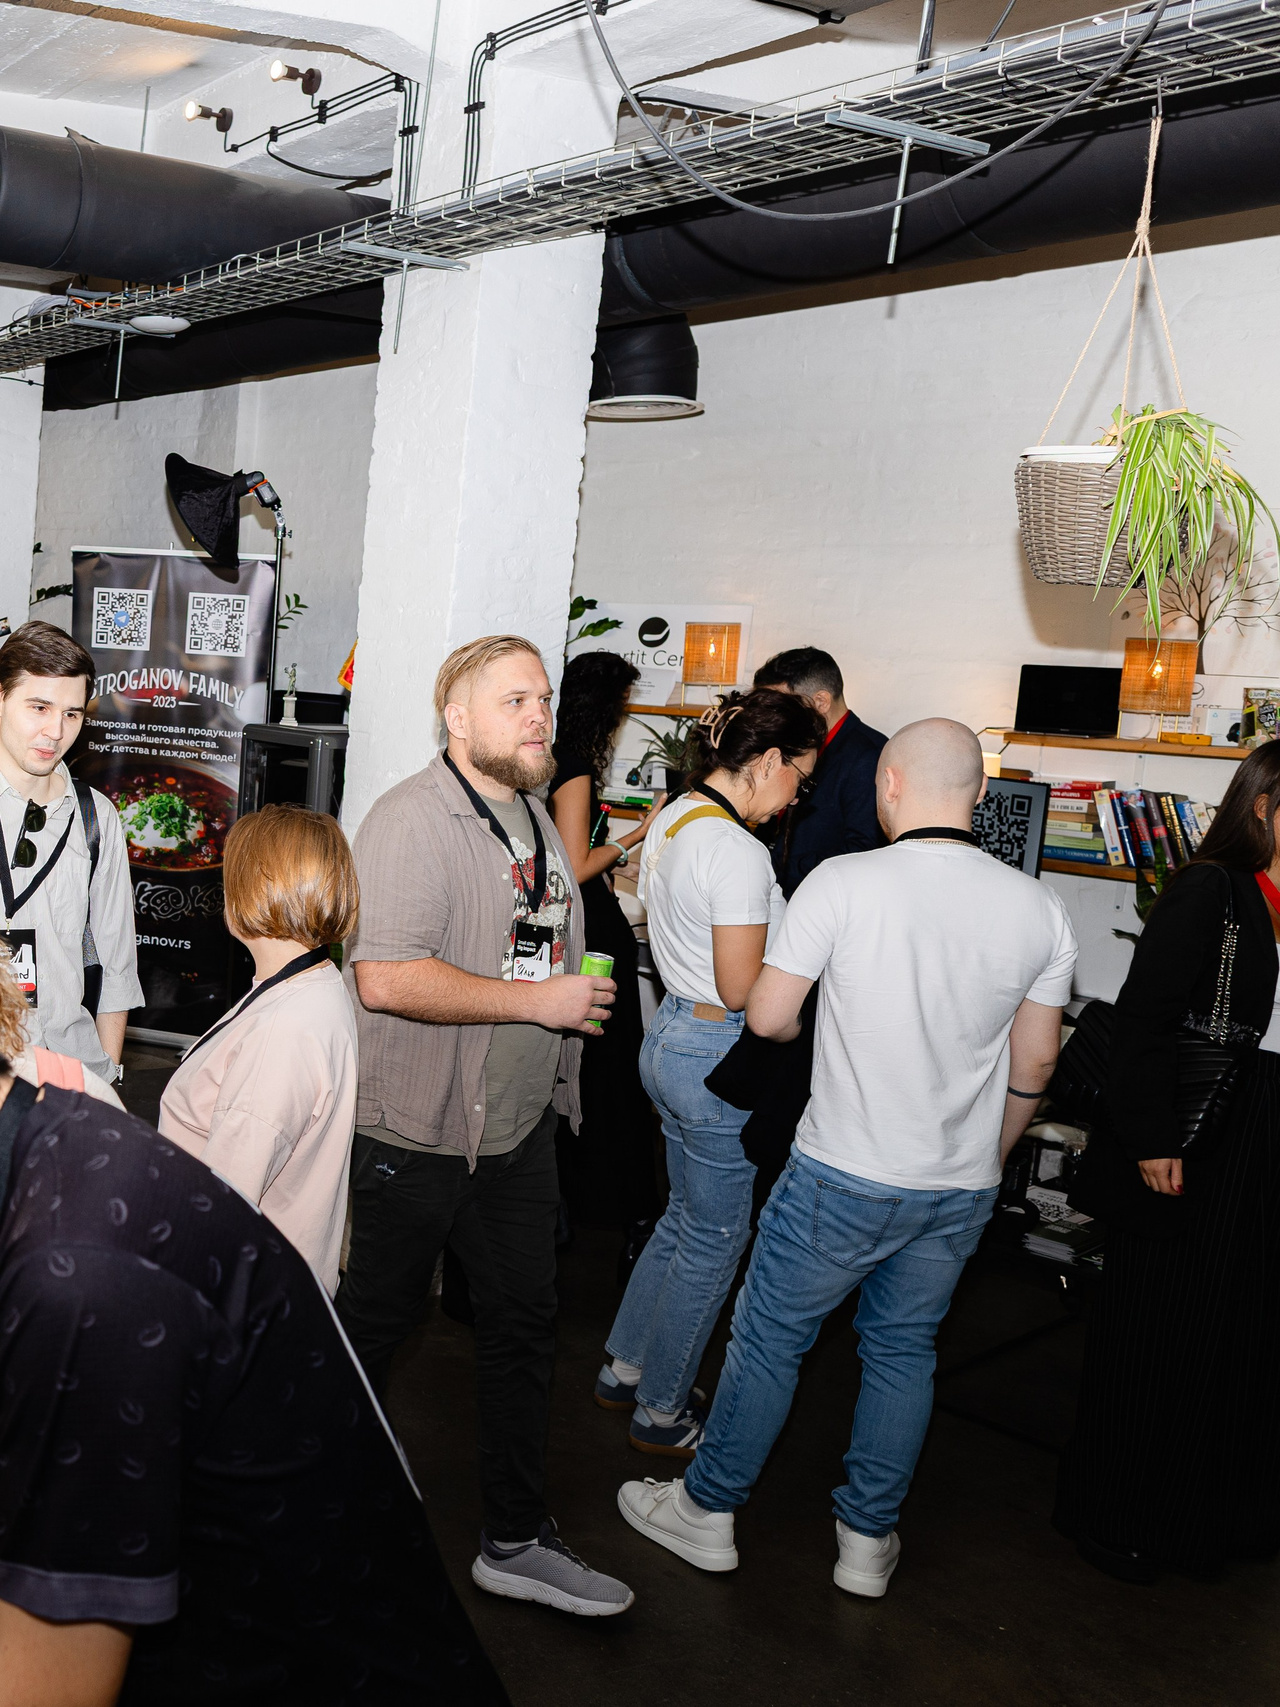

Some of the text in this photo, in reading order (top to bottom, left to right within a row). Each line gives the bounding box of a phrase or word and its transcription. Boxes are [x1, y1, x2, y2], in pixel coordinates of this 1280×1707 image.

[189, 672, 244, 709] FAMILY
[152, 695, 177, 708] 2023
[85, 717, 137, 730] Заморозка
[147, 724, 186, 734] готовая
[188, 727, 243, 739] продукция
[105, 732, 219, 749] высочайшего качества.
[88, 741, 237, 762] Вкус детства в каждом блюде!
[136, 934, 191, 950] ganov.rs
